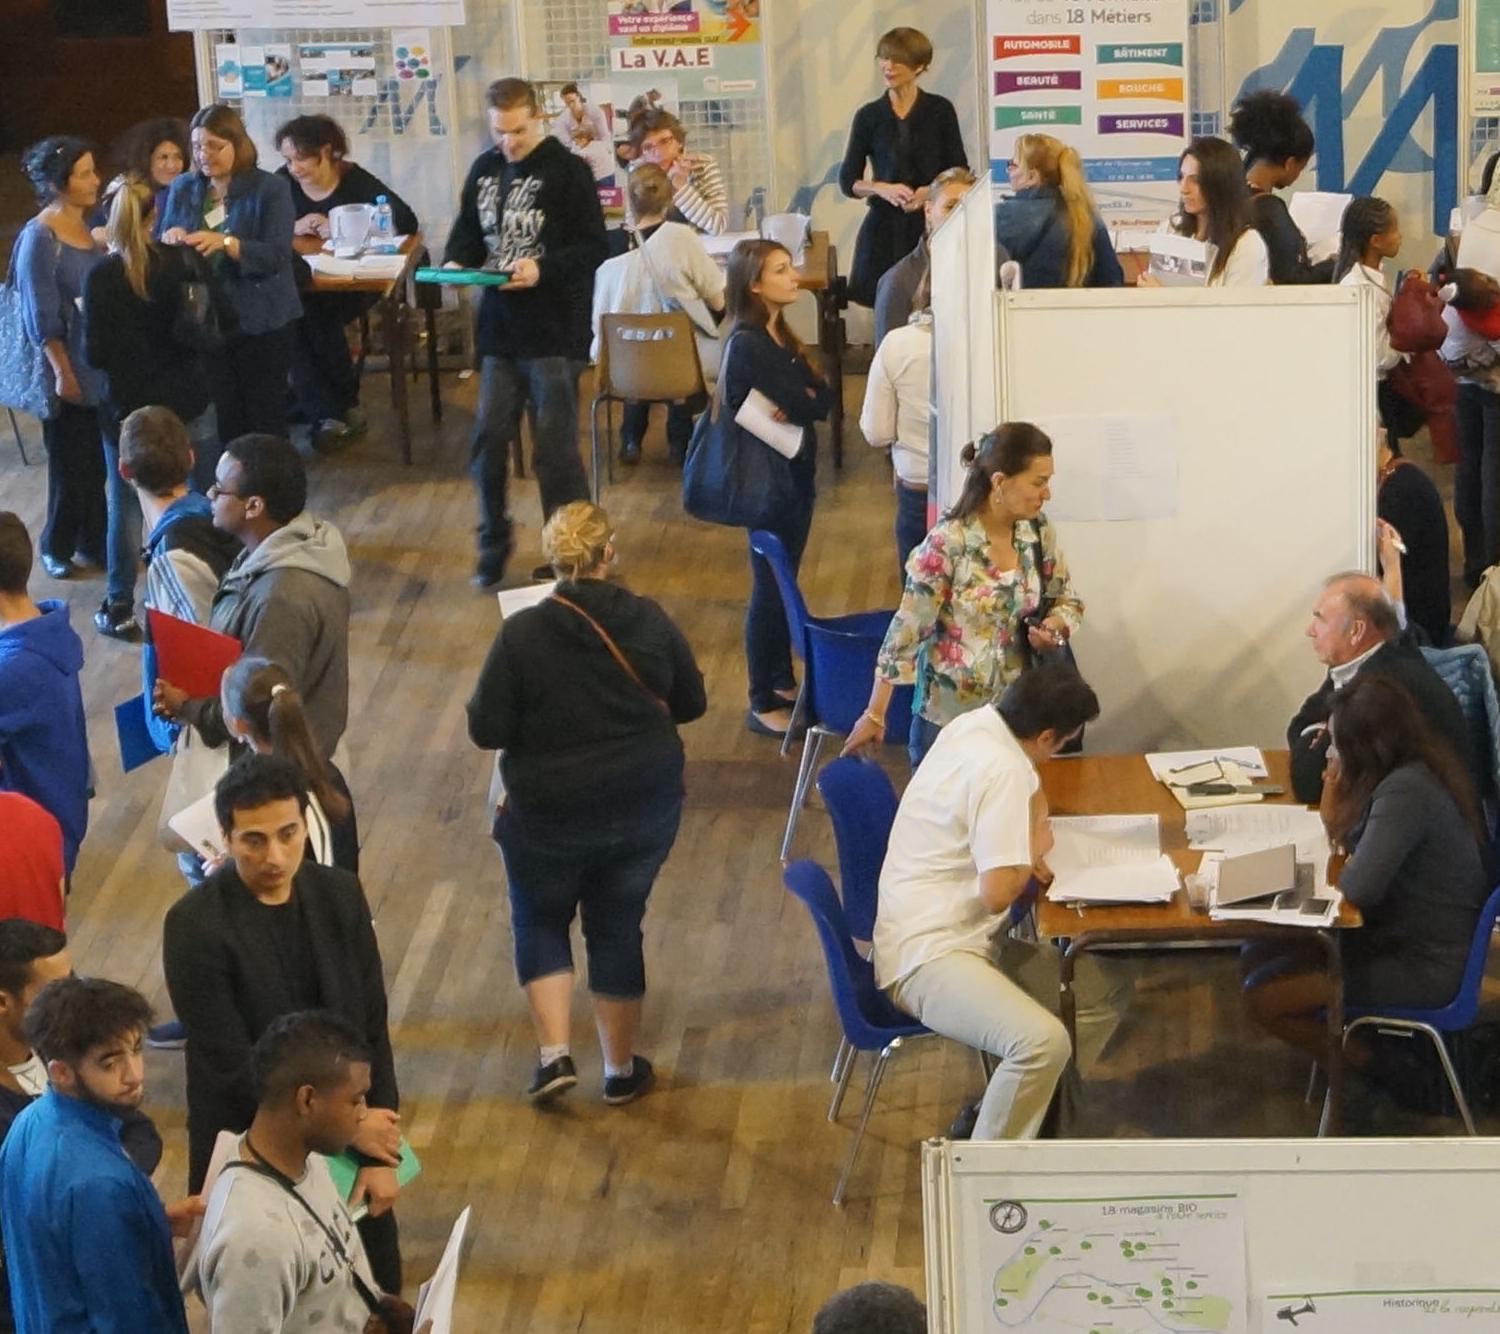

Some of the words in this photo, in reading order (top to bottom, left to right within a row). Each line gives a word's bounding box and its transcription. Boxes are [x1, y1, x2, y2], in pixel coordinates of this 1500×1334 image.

[1026, 10, 1062, 25] dans
[1066, 9, 1084, 24] 18
[1090, 8, 1152, 24] Métiers
[1003, 39, 1071, 49] AUTOMOBILE
[619, 51, 646, 69] La
[652, 47, 711, 67] V.A.E
[1016, 74, 1059, 86] BEAUTÉ
[1115, 118, 1169, 129] SERVICES
[1100, 1205, 1117, 1216] 18
[1382, 1298, 1440, 1308] Historique
